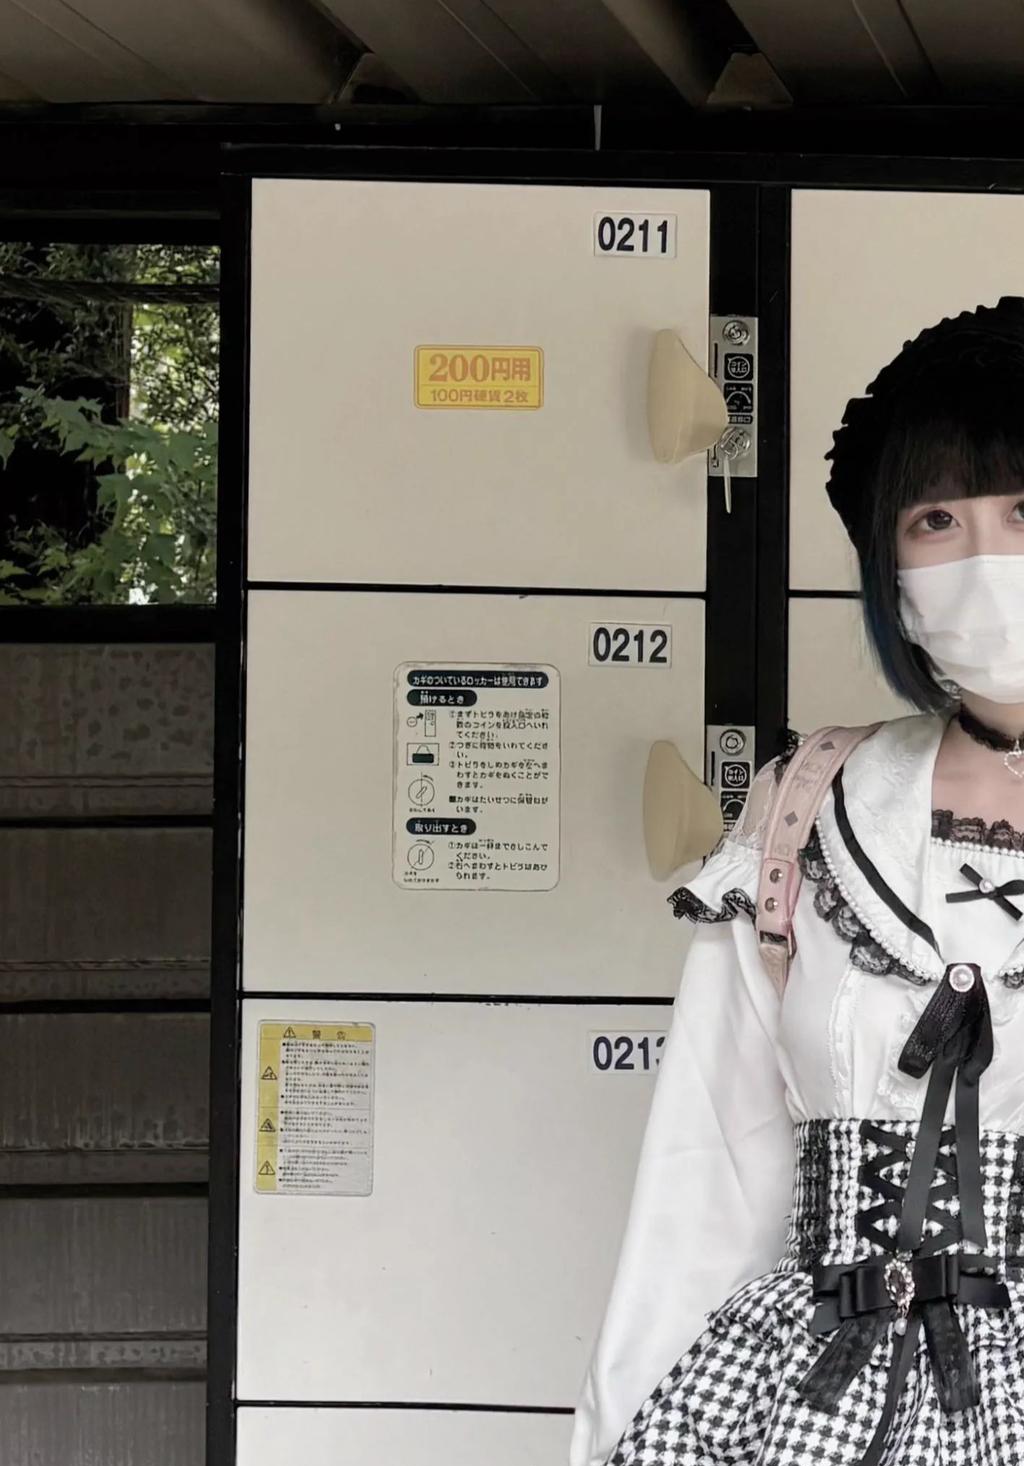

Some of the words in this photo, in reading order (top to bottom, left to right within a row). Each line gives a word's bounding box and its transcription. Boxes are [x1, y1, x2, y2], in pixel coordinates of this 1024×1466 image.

[597, 216, 668, 253] 0211
[428, 353, 531, 382] 200円用
[431, 388, 528, 403] 100円硬貨2枚
[593, 627, 667, 663] 0212
